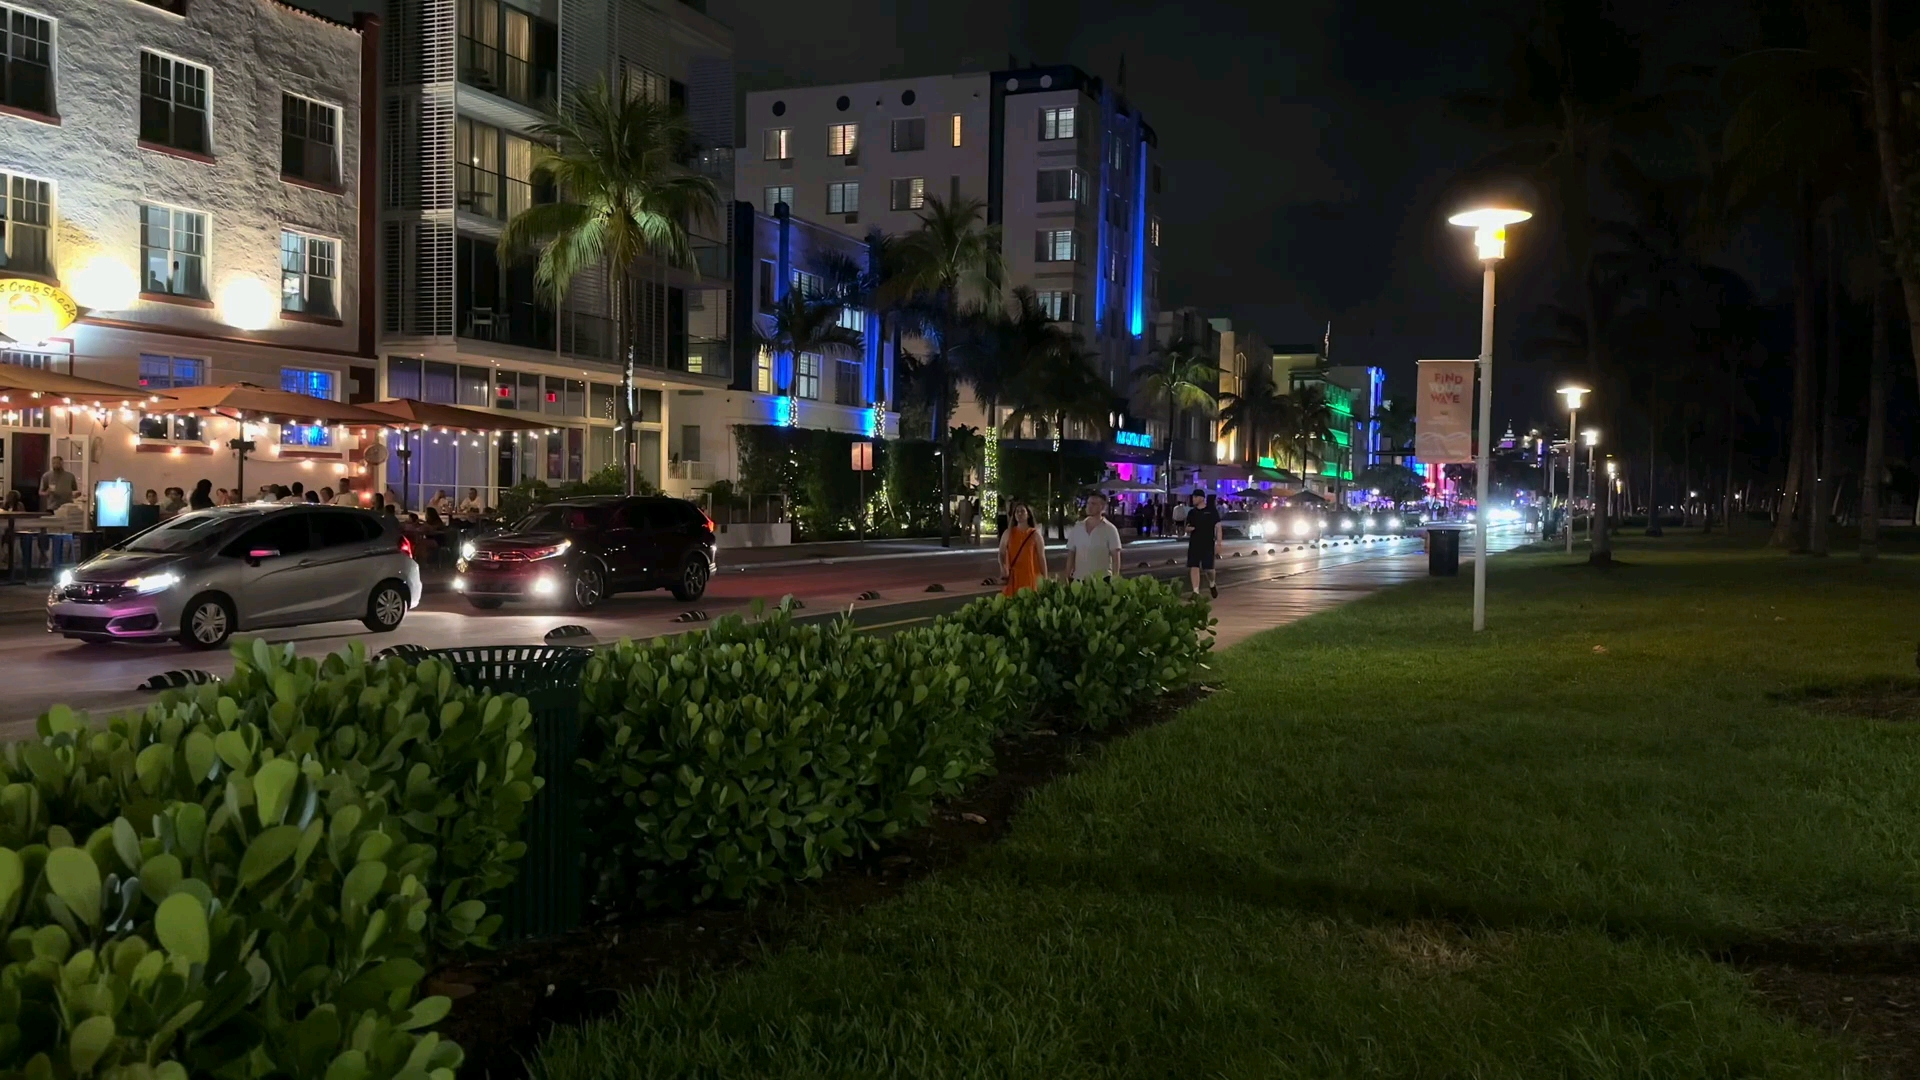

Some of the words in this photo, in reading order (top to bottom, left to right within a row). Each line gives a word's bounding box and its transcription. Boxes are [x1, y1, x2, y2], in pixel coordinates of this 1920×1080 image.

[9, 281, 39, 293] Crab
[1434, 373, 1463, 385] FIND
[1429, 382, 1463, 394] YOUR
[1431, 392, 1461, 404] WAVE
